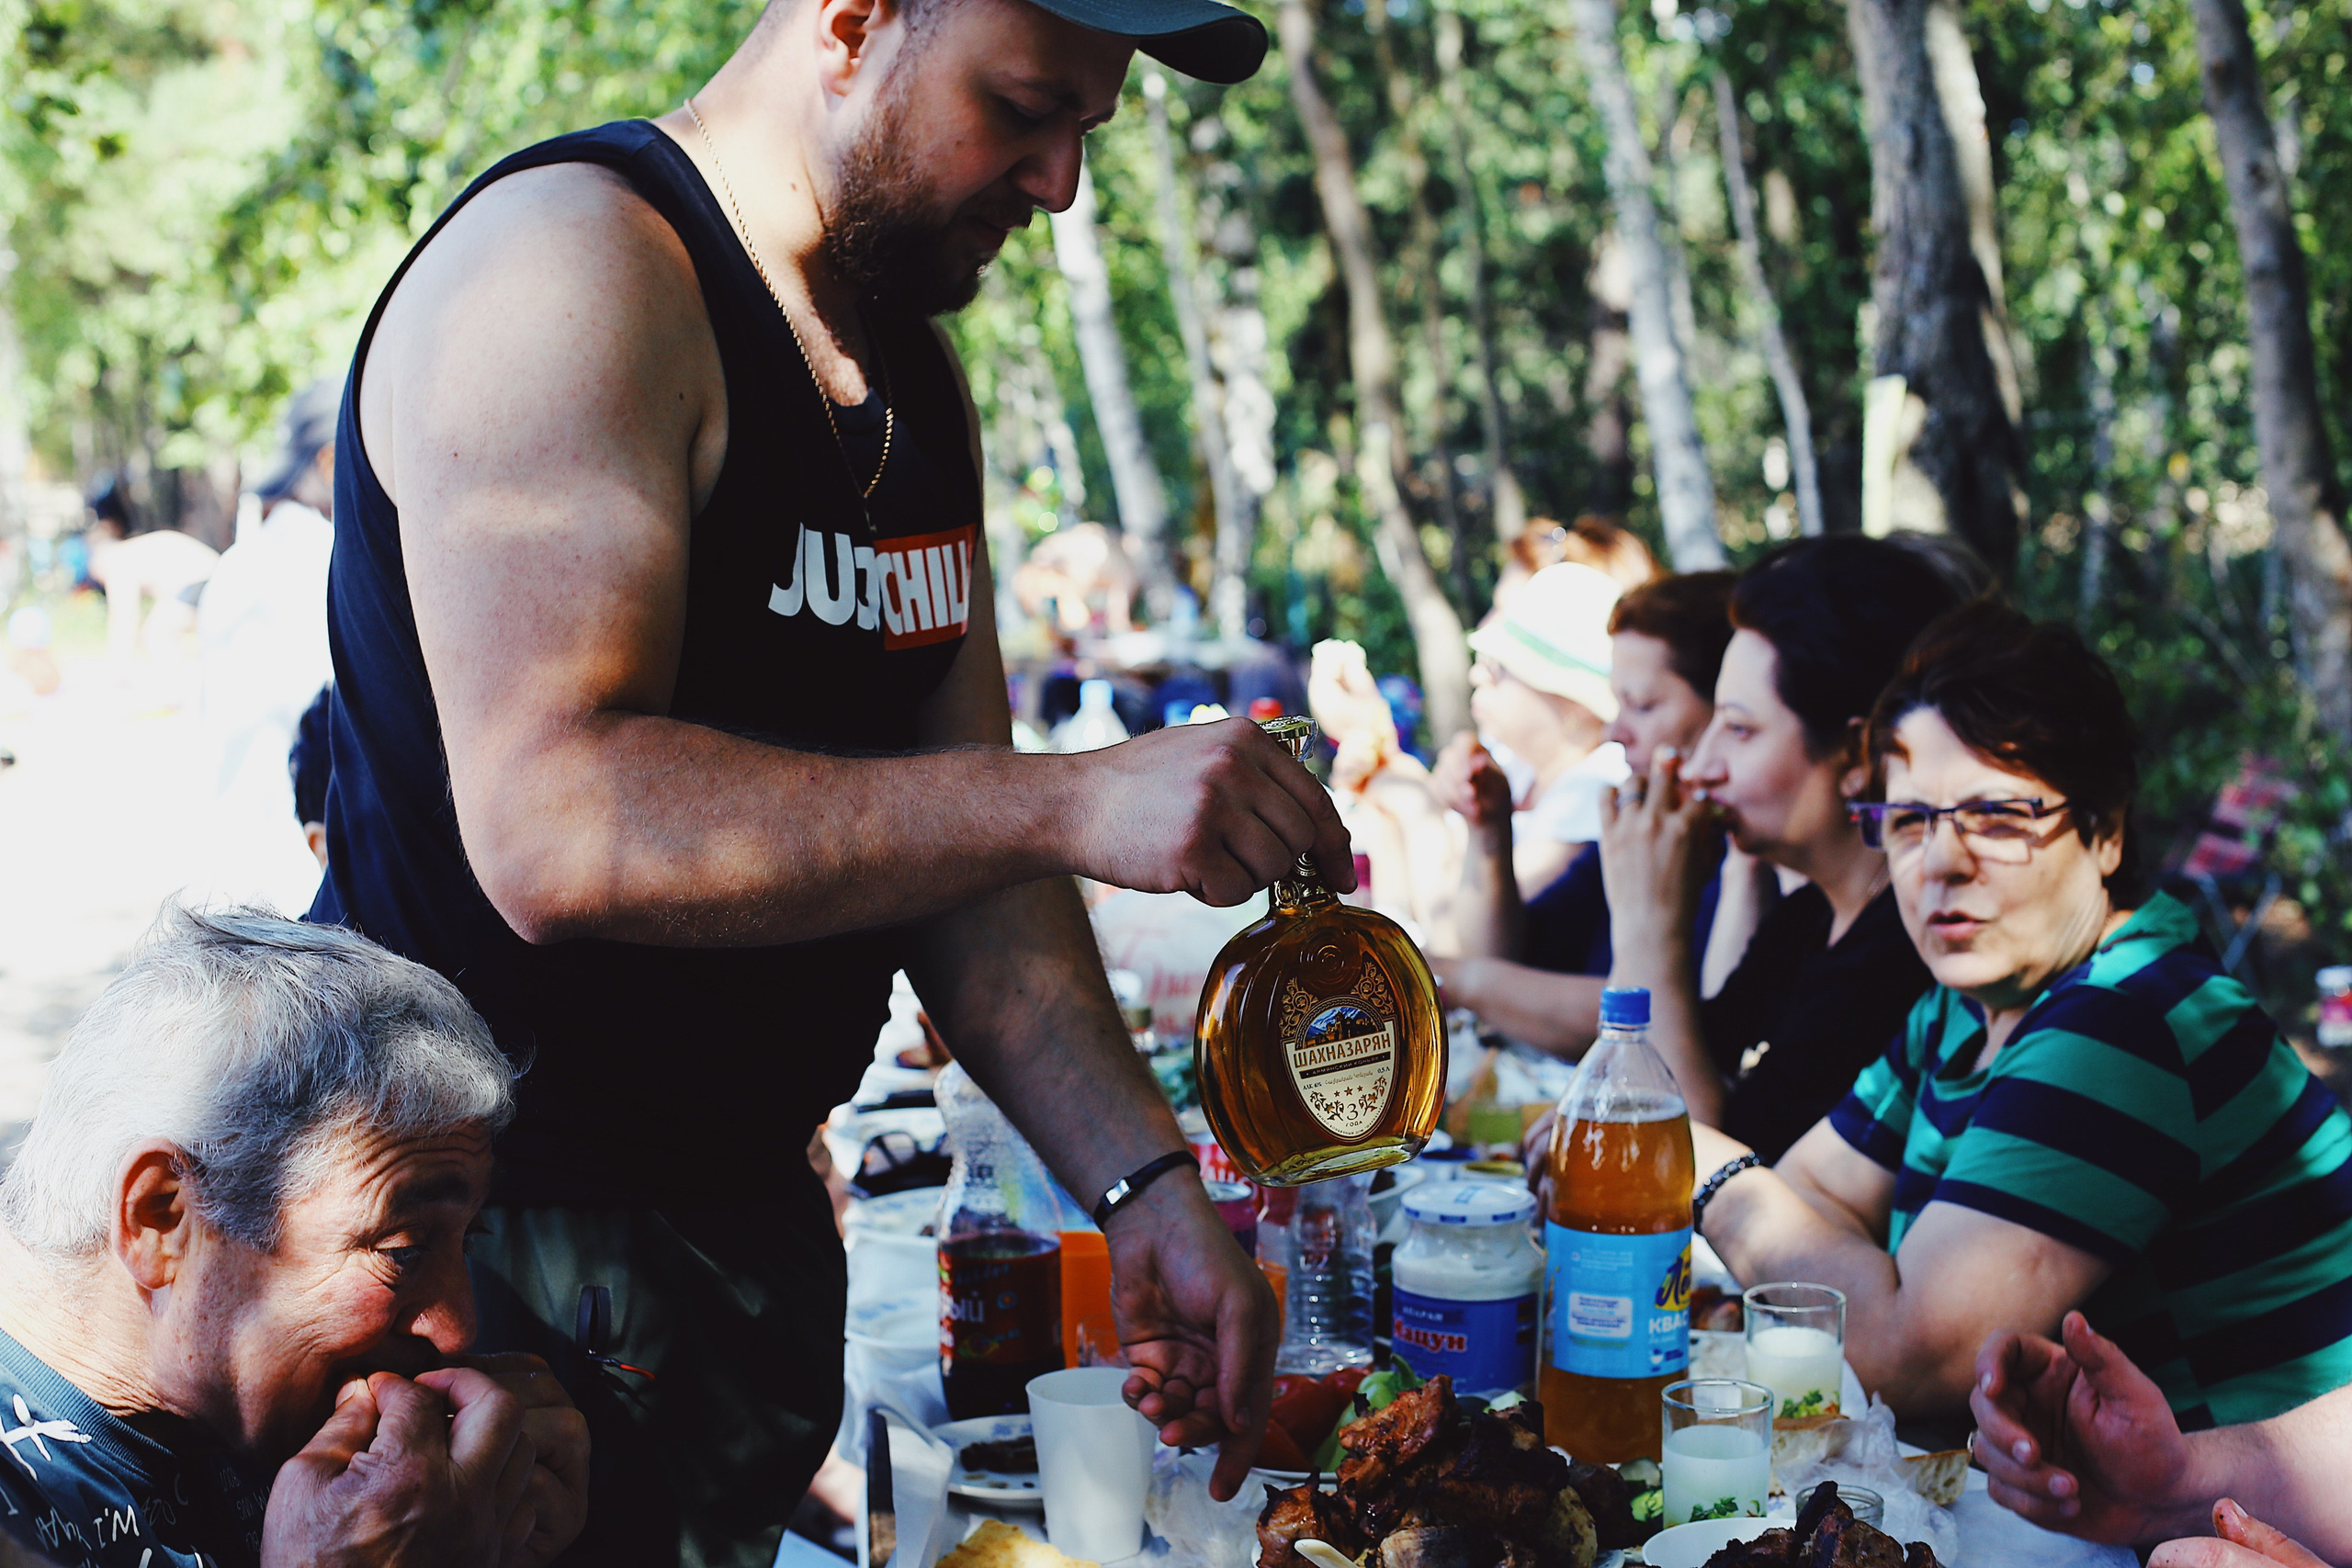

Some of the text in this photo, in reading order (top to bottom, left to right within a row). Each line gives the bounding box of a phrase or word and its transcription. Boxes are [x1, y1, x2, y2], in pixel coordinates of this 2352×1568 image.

[1293, 1032, 1391, 1068] ШАХНАЗАРЯН
[1312, 1055, 1379, 1075] АРМЯНСКИЙ КОНЬЯК
[1346, 1103, 1359, 1121] 3
